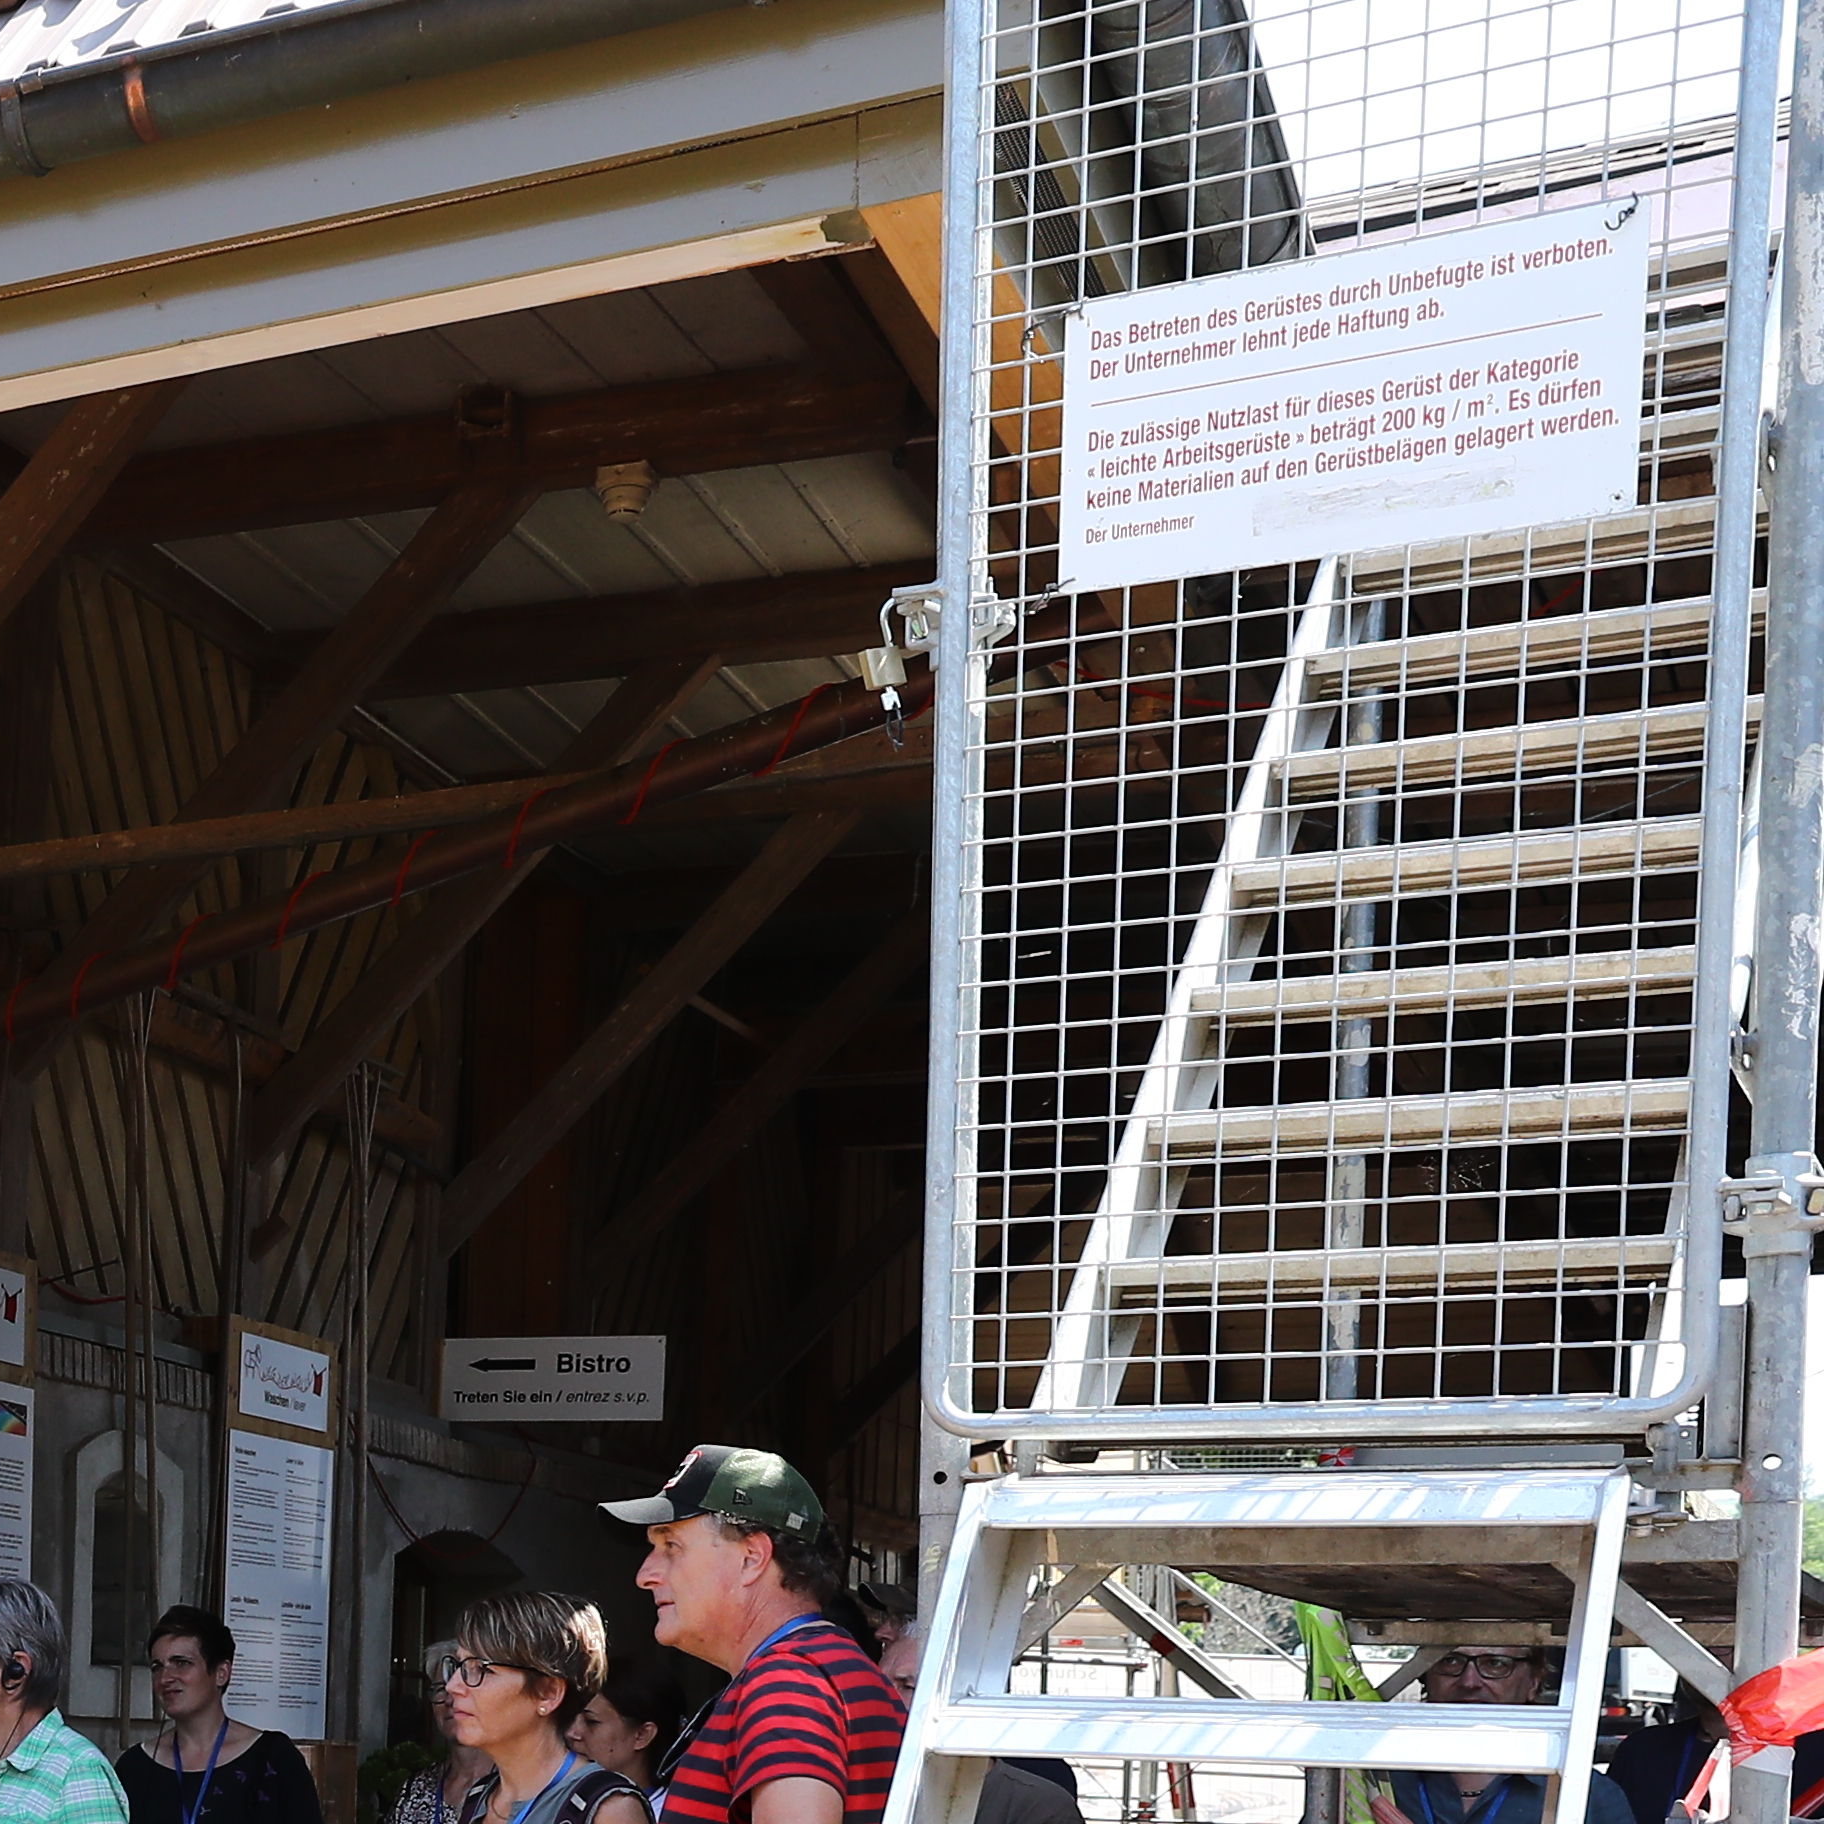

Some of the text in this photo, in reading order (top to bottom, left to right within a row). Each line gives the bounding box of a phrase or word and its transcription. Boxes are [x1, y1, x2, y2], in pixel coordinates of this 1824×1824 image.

[1090, 298, 1445, 380] Der Unternehmer lehnt jede Haftung ab.
[1091, 237, 1614, 351] Das Betreten des Gerüstes durch Unbefugte ist verboten.
[1088, 348, 1579, 452] Die zulässige Nutzlast für dieses Gerüst der Kategorie
[1101, 454, 1157, 479] leichte
[1162, 430, 1291, 470] Arbeitsgerüste
[1310, 416, 1376, 445] beträgt
[1382, 409, 1416, 433] 200
[1422, 403, 1445, 429] kg
[1451, 398, 1462, 422] /
[1508, 389, 1531, 412] Es
[1538, 378, 1602, 407] dürfen
[1086, 406, 1620, 511] keine Materialien auf den Gerüstbelägen gelagert werden.
[1085, 515, 1195, 545] Der Unternehmer
[453, 1389, 650, 1406] Treten Sie ein / entrez s.v.p.
[556, 1353, 631, 1374] Bistro
